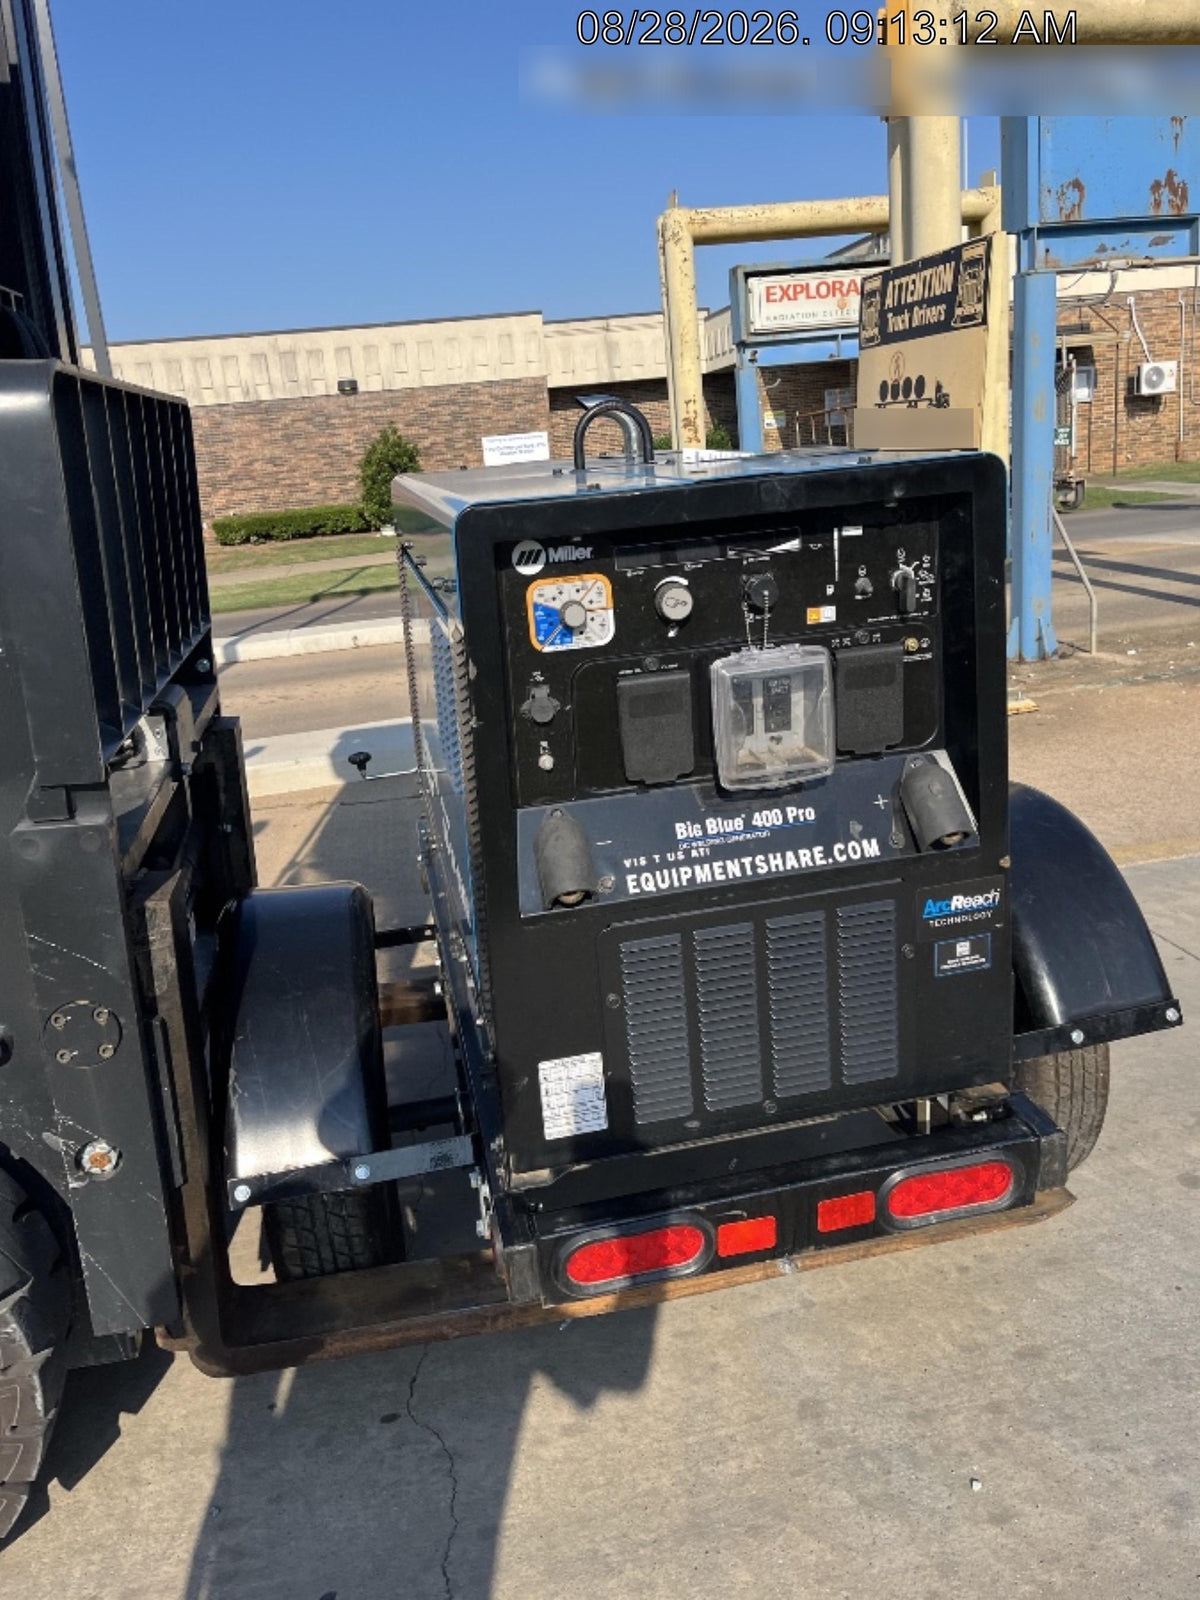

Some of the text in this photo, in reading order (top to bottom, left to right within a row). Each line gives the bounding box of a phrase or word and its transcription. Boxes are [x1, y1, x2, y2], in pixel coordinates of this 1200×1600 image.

[765, 280, 860, 303] EXPLORA
[884, 261, 956, 310] ATTENTION
[887, 303, 947, 333] Truck Drivers
[547, 546, 593, 563] Miller
[674, 821, 703, 840] Big
[751, 808, 783, 828] 400
[785, 806, 816, 824] Pro
[626, 838, 881, 894] EQUIPMENTSHARE.COM
[666, 850, 686, 862] US
[923, 888, 1000, 914] ArcReach
[929, 909, 993, 928] TECHNOLOGY
